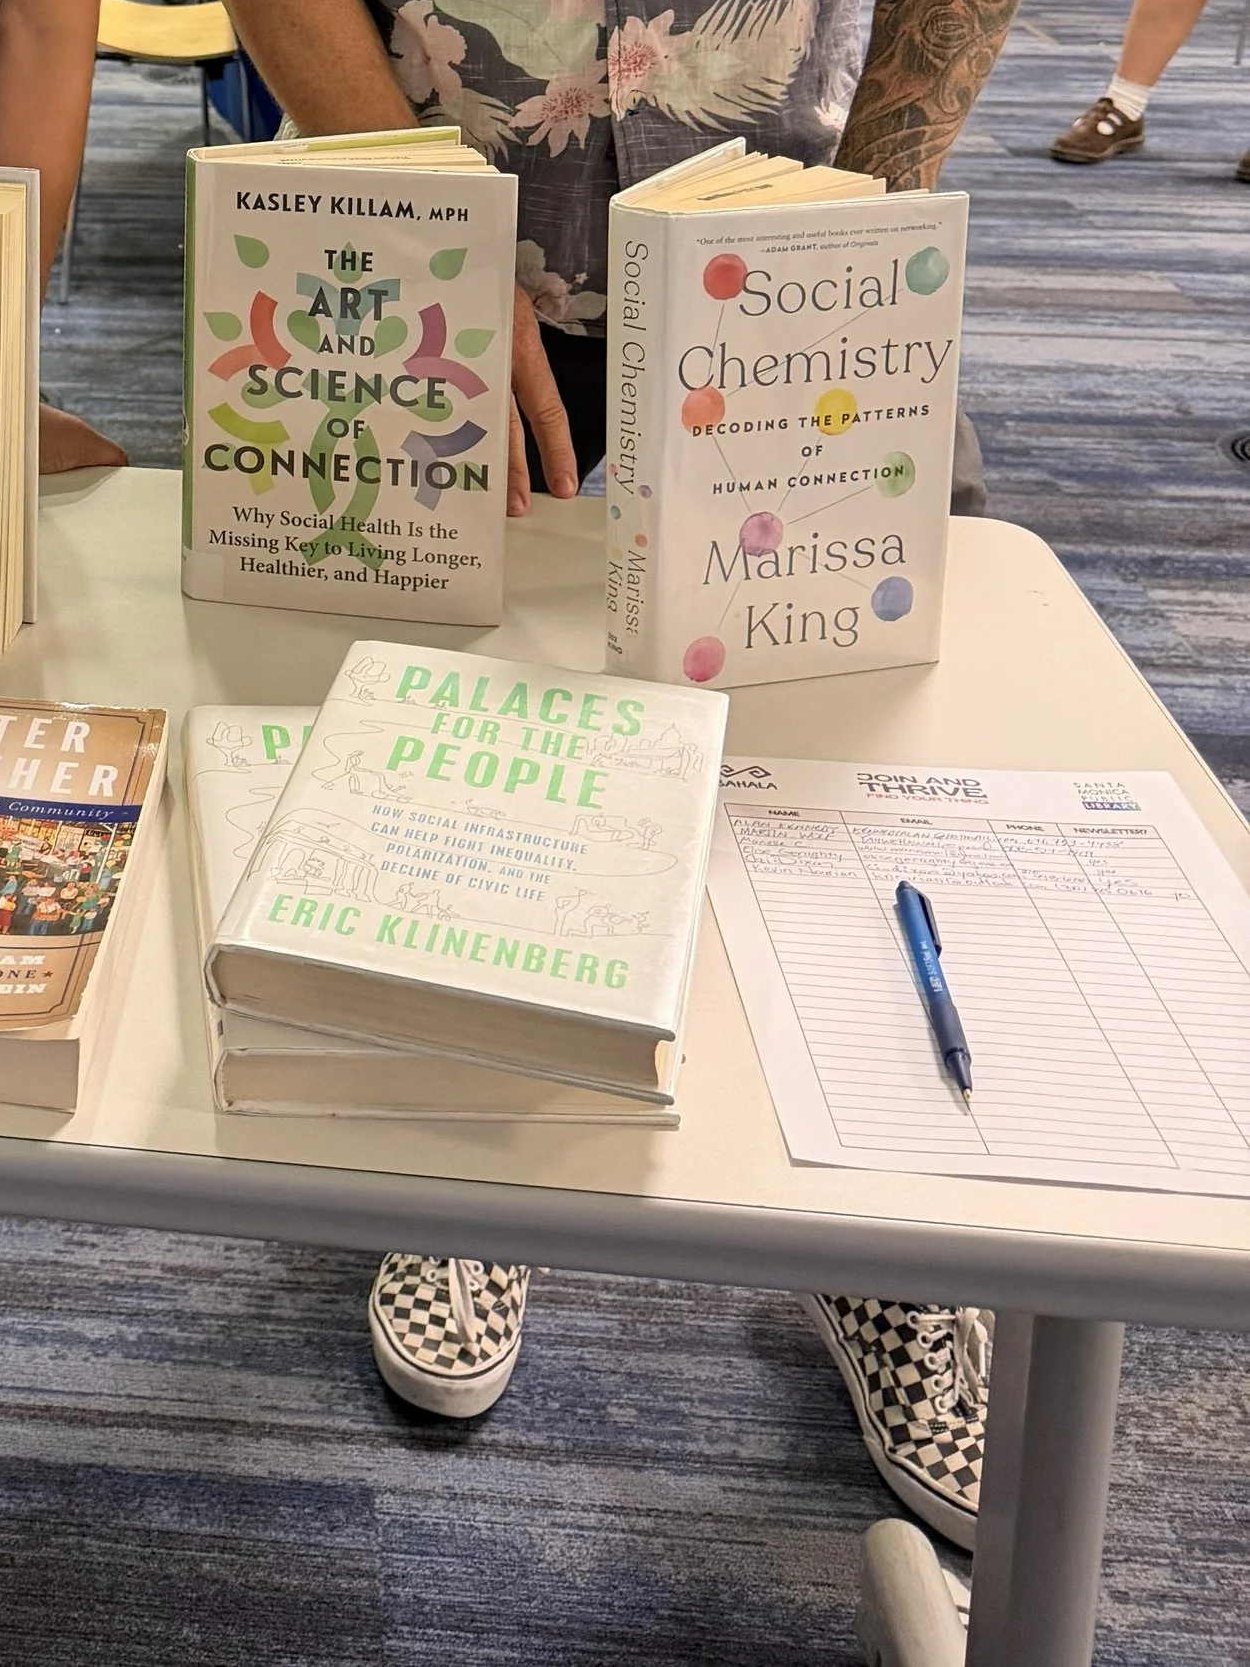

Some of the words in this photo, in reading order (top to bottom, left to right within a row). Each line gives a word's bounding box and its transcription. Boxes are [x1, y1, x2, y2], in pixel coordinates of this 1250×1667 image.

[236, 192, 322, 214] KASLEY
[331, 198, 421, 221] KILLAM,
[429, 206, 468, 222] MPH
[325, 250, 373, 271] THE
[308, 287, 388, 321] ART
[624, 240, 649, 332] Social
[740, 259, 899, 317] Social
[319, 335, 375, 356] AND
[678, 337, 954, 391] Chemistry
[247, 364, 446, 409] SCIENCE
[327, 418, 365, 439] OF
[615, 341, 646, 496] Chemistry
[692, 418, 789, 437] DECODING
[798, 415, 832, 428] THE
[841, 404, 930, 425] PATTERNS
[204, 444, 488, 491] CONNECTION
[802, 445, 824, 458] OF
[713, 476, 778, 495] HUMAN
[787, 465, 905, 489] CONNECTION
[233, 506, 275, 529] Why
[280, 510, 334, 530] Social
[340, 516, 402, 536] Health
[407, 521, 423, 537] Is
[429, 523, 458, 539] the
[209, 529, 280, 554] Missing
[285, 536, 319, 558] Key
[324, 542, 342, 556] to
[347, 542, 406, 566] Living
[412, 547, 482, 572] Longer,
[702, 532, 905, 586] Marissa
[239, 557, 328, 581] Healthier,
[334, 566, 368, 583] and
[373, 569, 449, 591] Happier
[607, 561, 623, 613] King
[745, 602, 861, 650] King
[395, 666, 644, 736] PALACES
[431, 712, 500, 745] FOR
[523, 726, 582, 761] THE
[386, 735, 609, 809] PEOPLE
[856, 772, 918, 783] JOIN
[925, 776, 981, 786] AND
[859, 782, 987, 798] THRIVE
[9, 801, 115, 819] Community
[269, 894, 360, 936] ERIC
[376, 914, 629, 990] KLINENBERG
